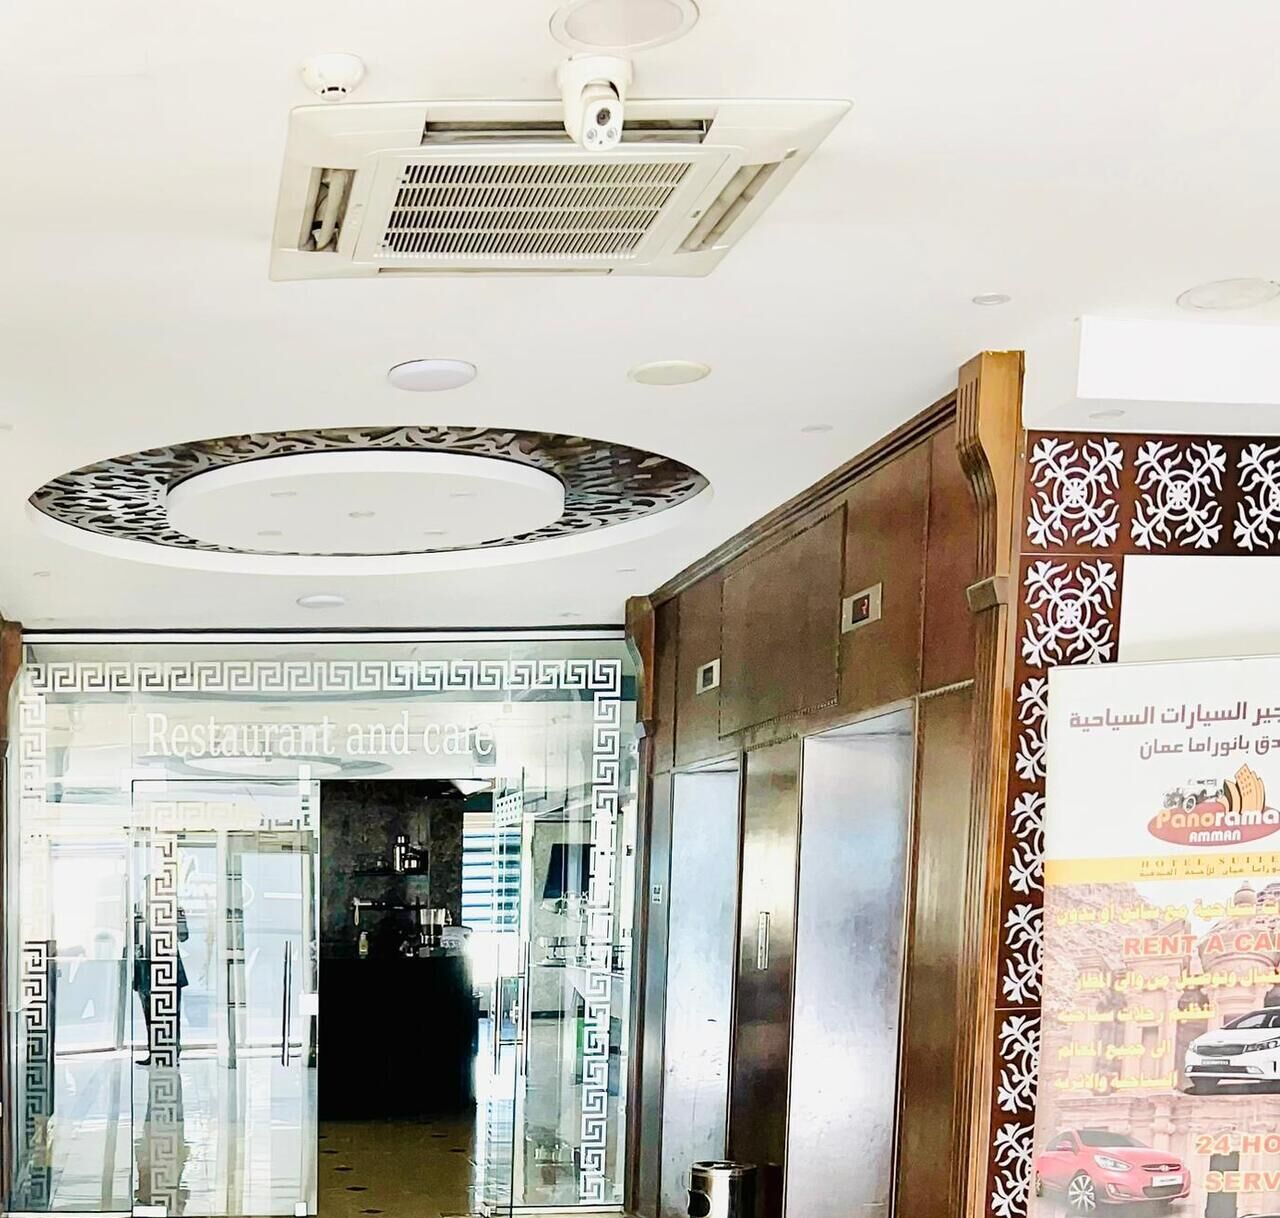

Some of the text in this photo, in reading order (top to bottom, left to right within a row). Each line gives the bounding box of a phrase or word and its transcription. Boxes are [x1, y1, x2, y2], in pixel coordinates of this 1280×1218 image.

[1069, 705, 1155, 733] السياحية
[1161, 701, 1247, 730] السيارات
[145, 712, 336, 757] Restaurant
[346, 710, 411, 756] and
[1139, 738, 1184, 761] عمان
[1188, 734, 1250, 757] بانوراما
[1155, 809, 1280, 829] Panorama
[1188, 829, 1242, 843] AMMAN
[1122, 935, 1197, 955] RENT
[1206, 934, 1227, 953] A
[1197, 1133, 1280, 1155] 24 HO
[1205, 1171, 1280, 1192] SERV
